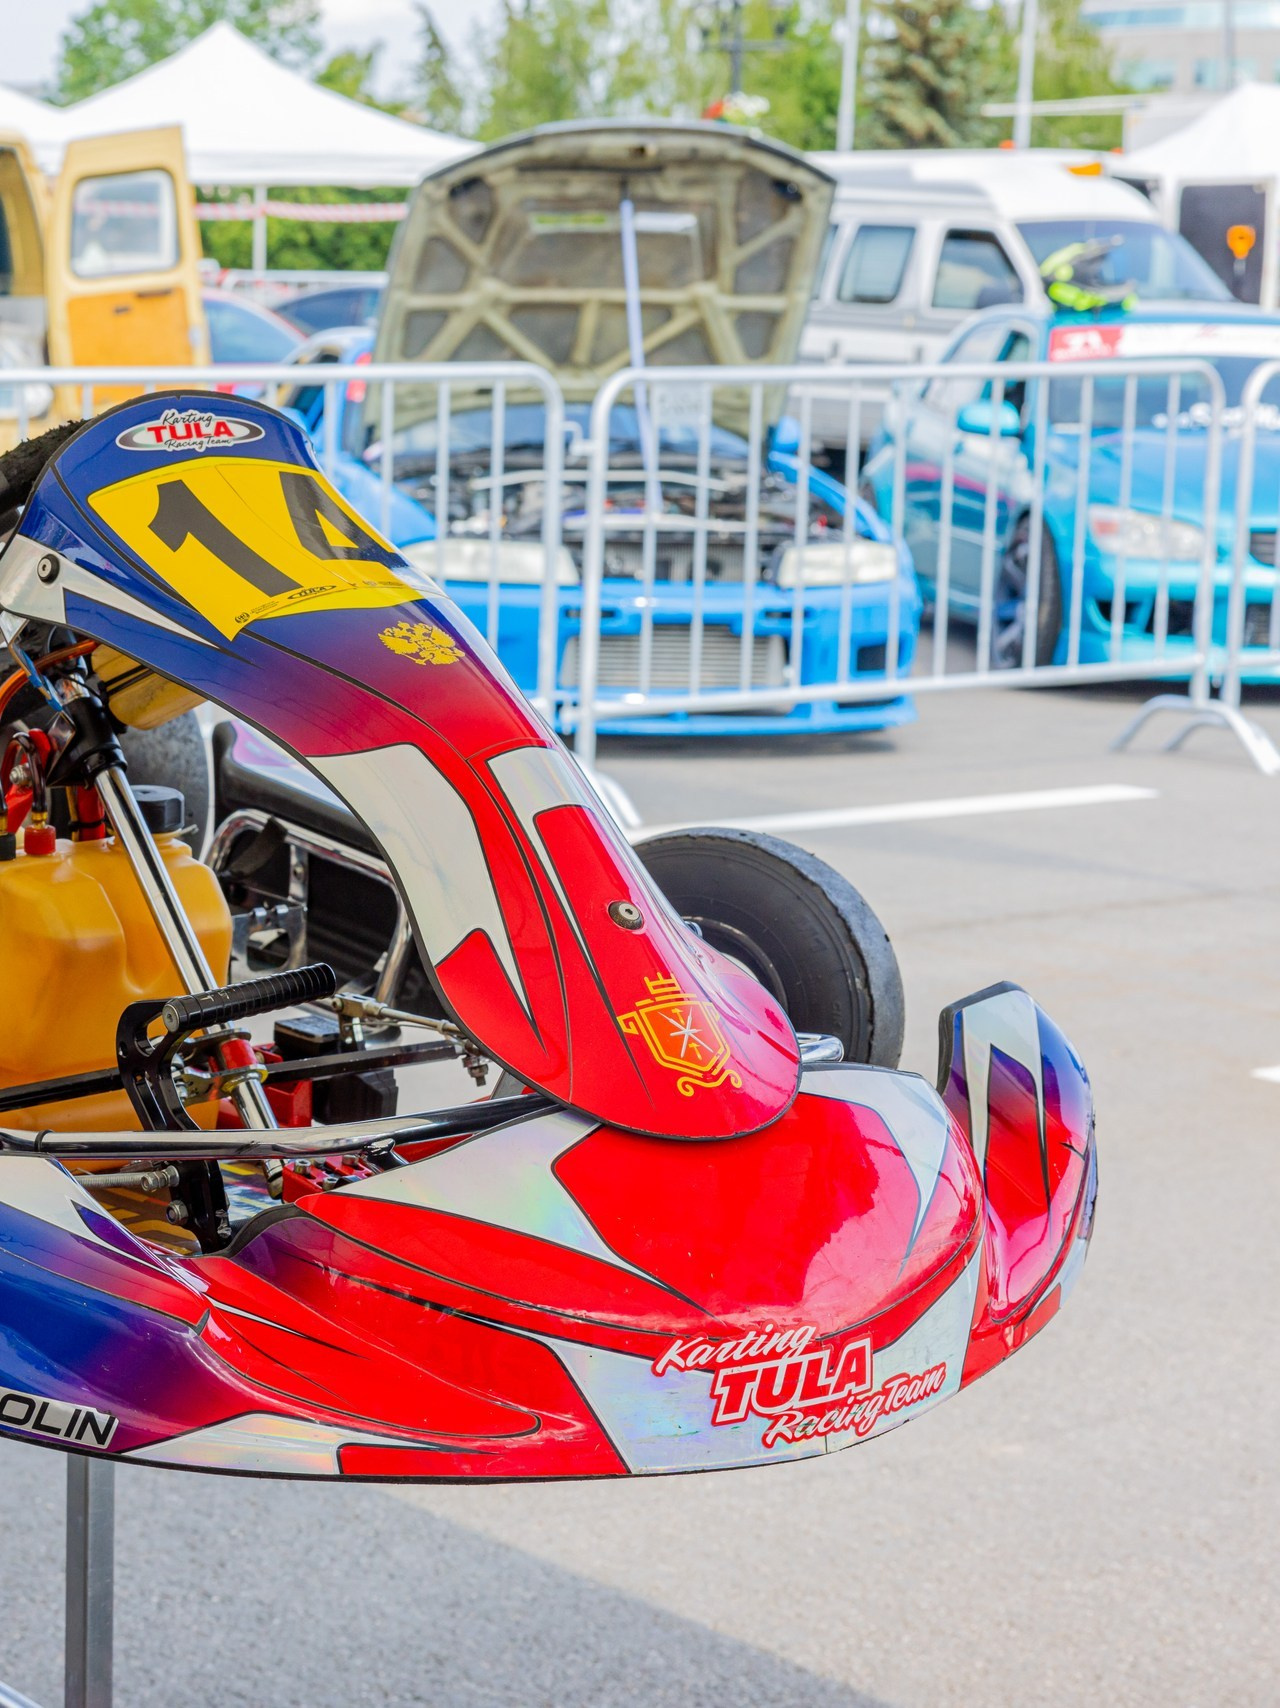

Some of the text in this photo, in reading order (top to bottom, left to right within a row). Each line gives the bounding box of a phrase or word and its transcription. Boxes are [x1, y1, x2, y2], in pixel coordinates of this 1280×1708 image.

[147, 421, 235, 443] TULA
[163, 413, 213, 427] Karting
[164, 436, 232, 449] Racing Team
[149, 471, 408, 597] 14
[656, 1324, 816, 1373] Karting
[714, 1338, 871, 1423] TULA
[765, 1366, 946, 1445] Racing Team
